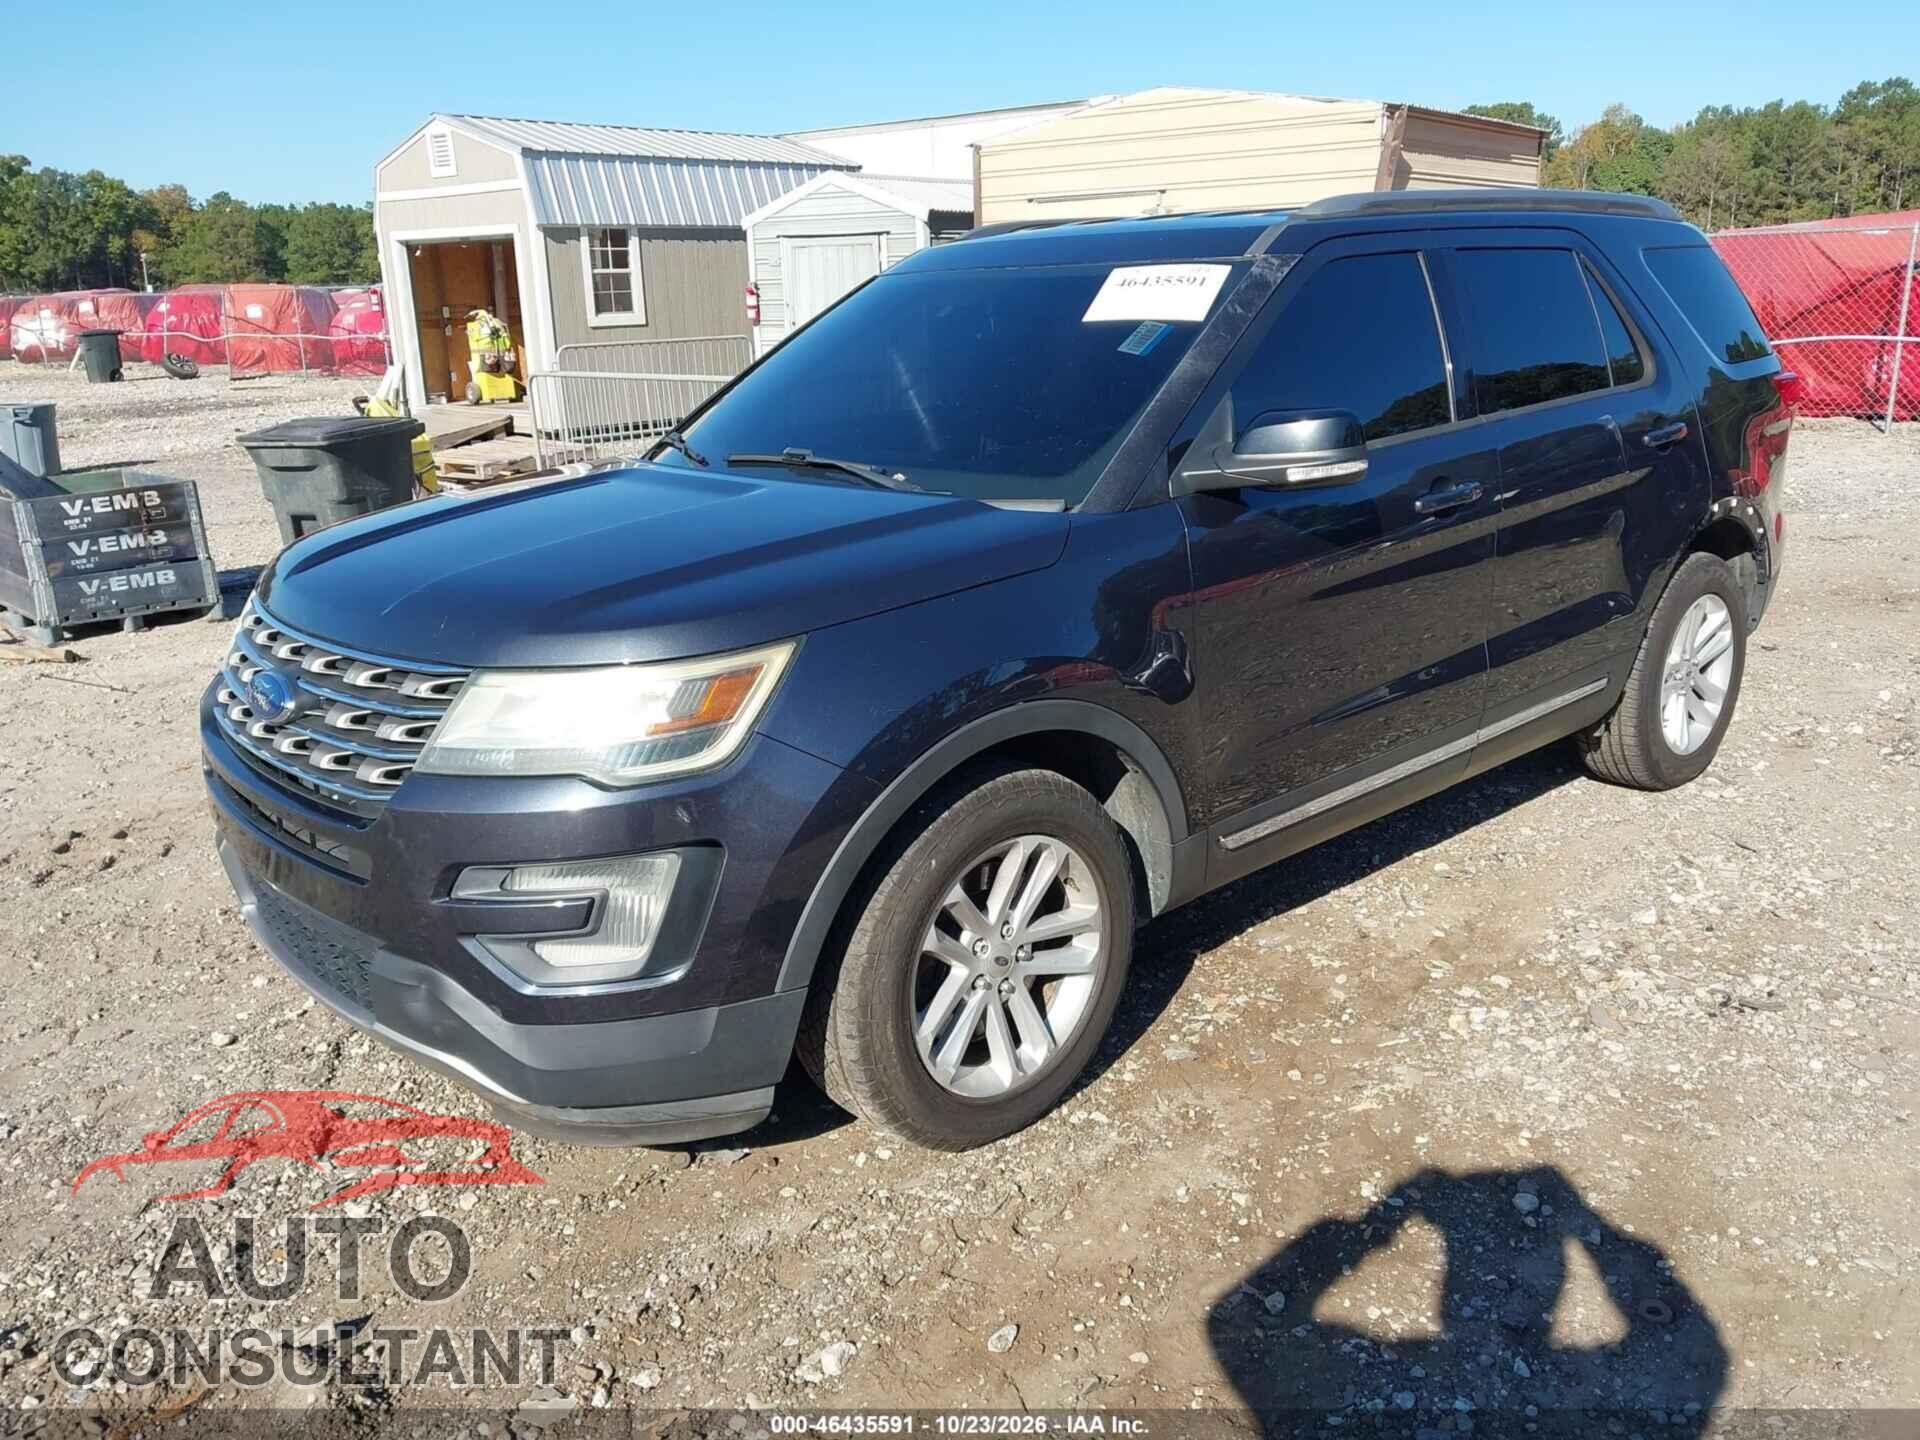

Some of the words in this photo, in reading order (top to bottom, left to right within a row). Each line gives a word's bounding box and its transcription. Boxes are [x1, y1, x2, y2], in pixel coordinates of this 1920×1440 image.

[1115, 275, 1207, 288] 46435591
[60, 490, 161, 516] V-EMB
[67, 529, 168, 556] V-EMB
[78, 569, 177, 595] V-EMB
